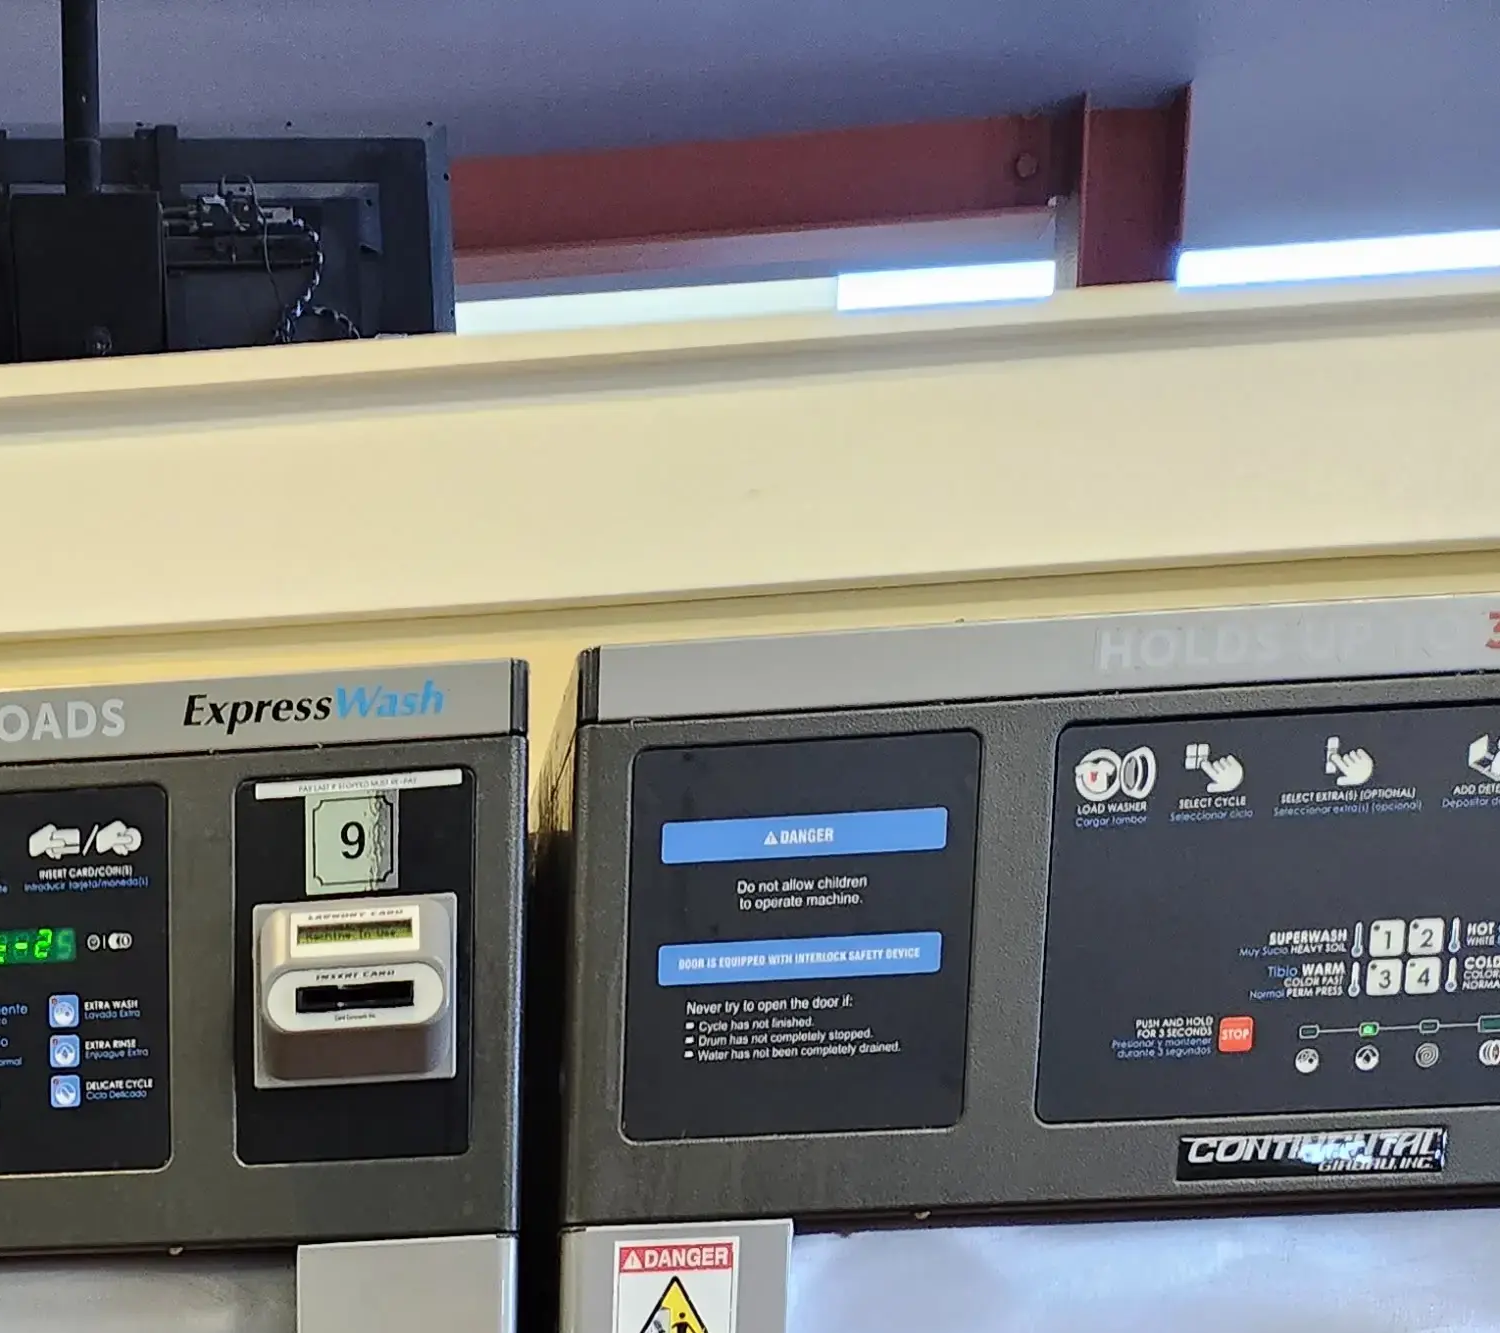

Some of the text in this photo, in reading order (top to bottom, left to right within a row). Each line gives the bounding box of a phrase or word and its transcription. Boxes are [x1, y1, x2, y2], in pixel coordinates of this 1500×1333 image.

[1100, 622, 1279, 670] HOLDS
[1453, 784, 1476, 795] ADD
[1179, 796, 1246, 810] SELECT CYCLE
[1281, 792, 1314, 804] SELECT
[1077, 801, 1147, 816] LOAD WASHER
[1169, 808, 1253, 822] Seleccionar ciclo
[1274, 806, 1330, 816] Seleccionar
[1075, 814, 1147, 828] Cargar tambor
[340, 821, 365, 859] 9
[780, 828, 834, 844] DANGER
[39, 868, 67, 879] INSERT
[24, 880, 66, 891] Introducir
[737, 876, 868, 894] Do not allow children
[740, 893, 863, 911] to operate machine.
[1467, 922, 1495, 936] HOT
[1269, 929, 1347, 945] SUPERWASH
[1384, 931, 1391, 949] 1
[1420, 929, 1434, 948] 2
[1466, 935, 1495, 946] WHITE
[1239, 943, 1346, 957] Muy Sucio HEAVY SOIL
[678, 948, 920, 970] DOOR IS EQUIPPED WITH INTERLOCK SAFETY DEVICE
[316, 972, 358, 980] INSERT
[1268, 962, 1345, 977] Tibio WARM
[1417, 967, 1430, 986] 4
[1284, 976, 1343, 988] COLOR FAST
[1378, 969, 1391, 988] 3
[1250, 986, 1343, 1000] Normal PERM PRESS
[84, 1000, 138, 1012] EXTRA WASH
[686, 994, 852, 1016] Never try to open the door if:
[85, 1009, 141, 1020] Lavado Extra
[699, 1016, 814, 1034] Cycle has not finished.
[1136, 1016, 1213, 1028] PUSH AND HOLD
[699, 1028, 873, 1047] Drum has not completely stopped.
[1137, 1025, 1212, 1038] FOR 3 SECONDS
[1221, 1028, 1250, 1042] STOP
[85, 1039, 136, 1050] EXTRA RINSE
[1111, 1037, 1211, 1049] Presionar y mantener
[85, 1048, 149, 1060] Enjuague Extra
[698, 1041, 900, 1062] Water has not been completely drained.
[1118, 1047, 1211, 1059] durante 3 segundos
[86, 1078, 153, 1090] DELICATE CYCLE
[86, 1089, 147, 1100] Ciclo Delicado
[1399, 1156, 1433, 1169] INC.
[644, 1247, 728, 1268] DANGER
